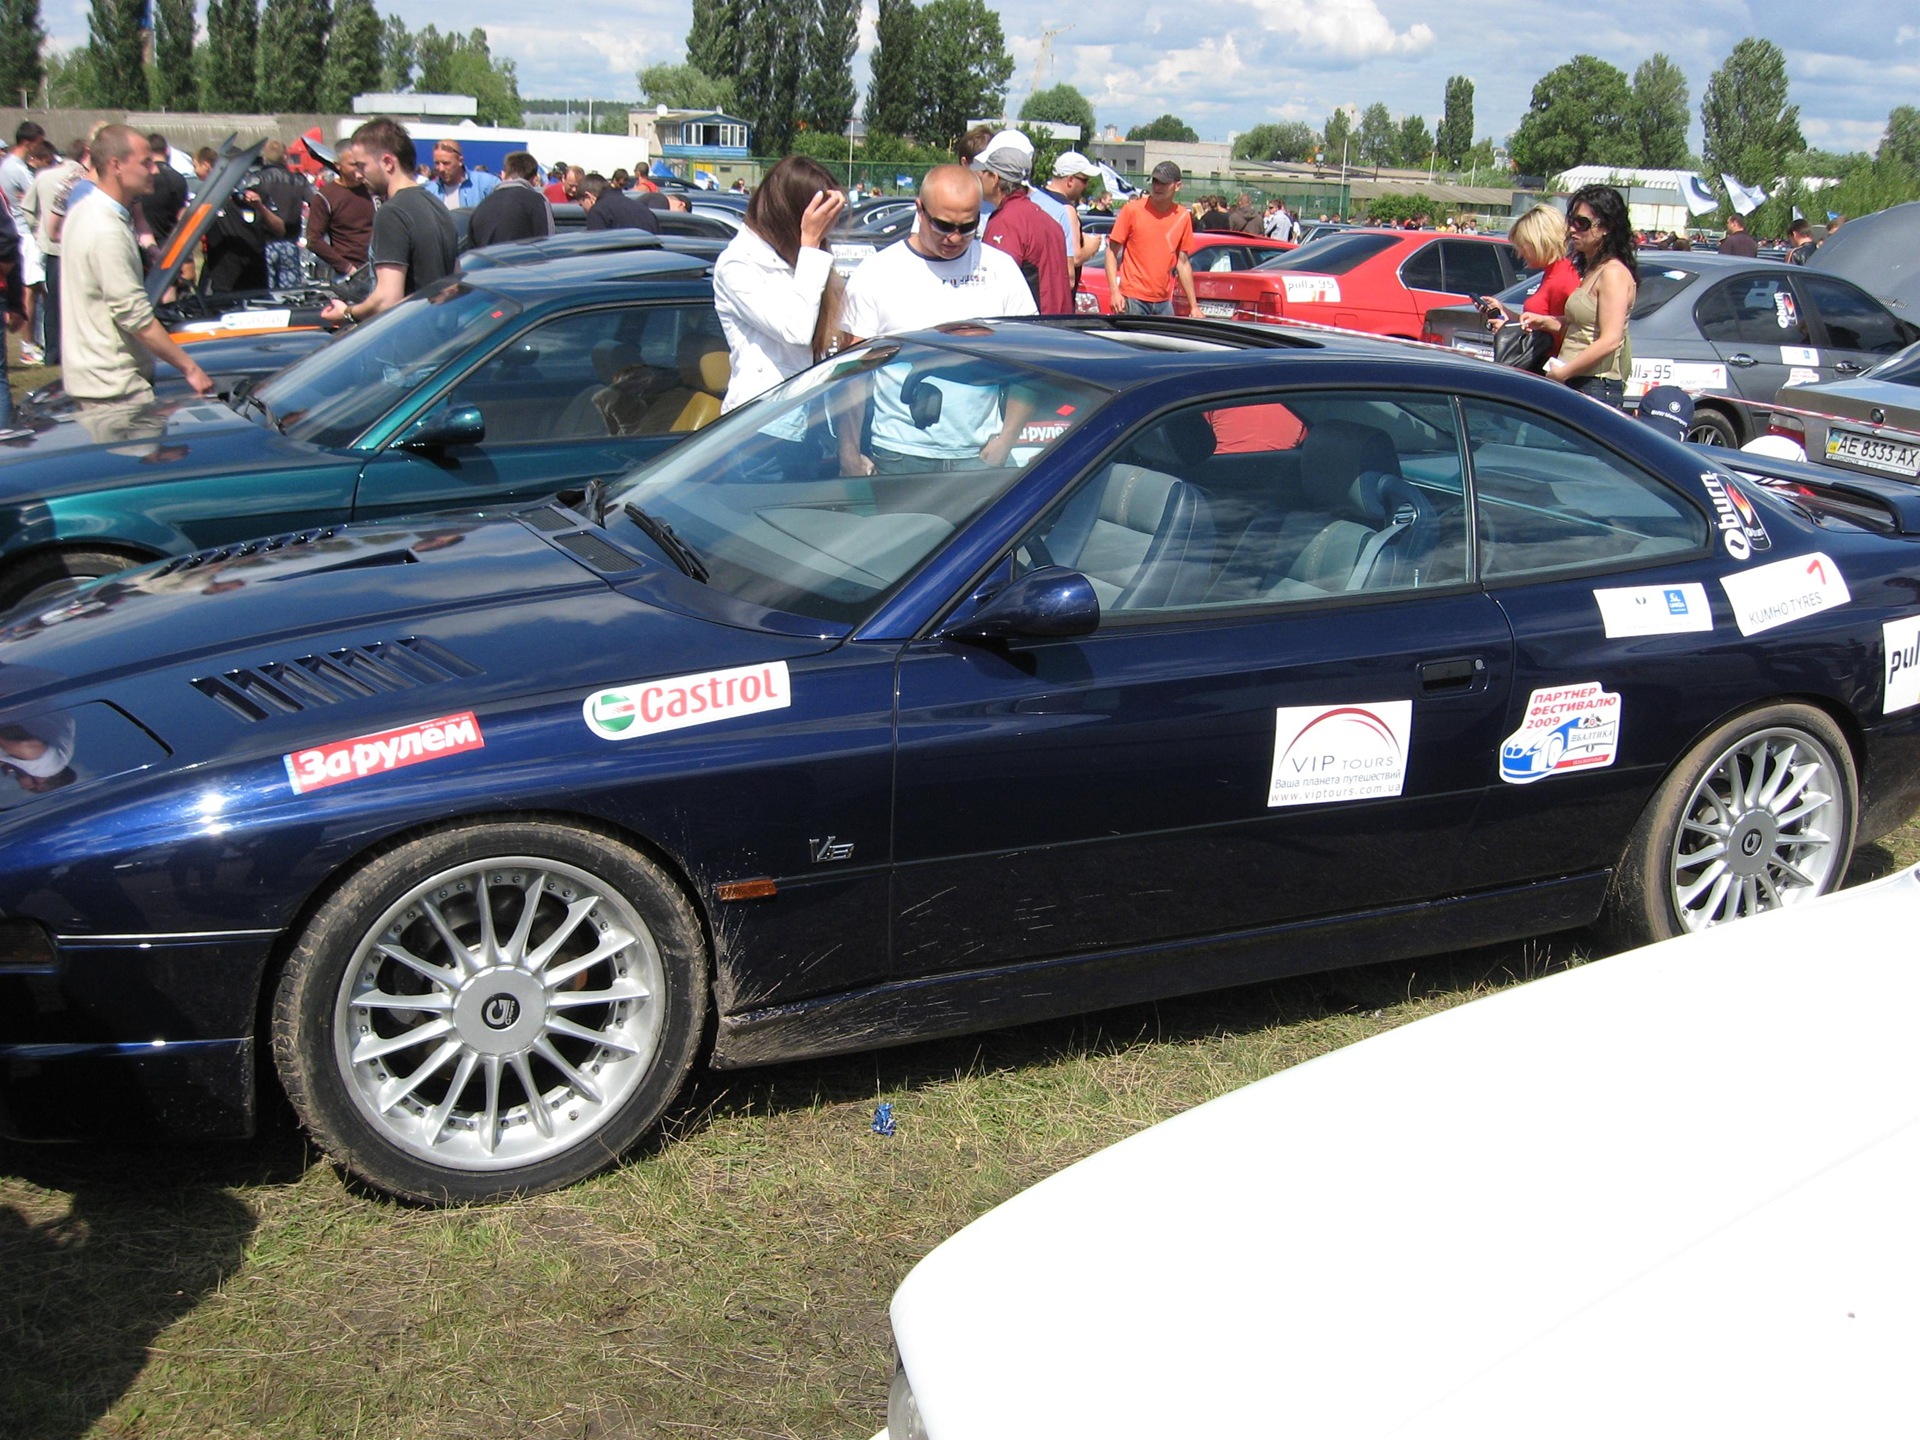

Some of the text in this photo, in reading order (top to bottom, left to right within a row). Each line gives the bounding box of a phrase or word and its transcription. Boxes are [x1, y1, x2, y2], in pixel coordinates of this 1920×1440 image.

[1653, 364, 1672, 380] 95
[1837, 436, 1860, 455] AE
[1861, 440, 1896, 462] 8333
[1896, 448, 1919, 467] AX
[1700, 472, 1741, 530] burn
[1749, 591, 1823, 625] KUMHO TYRES
[640, 668, 778, 724] Castrol
[1533, 687, 1598, 704] ПАРТНЕР
[1530, 697, 1618, 716] ФЕСТИВАЛЮ
[1526, 716, 1561, 729] 2009
[1291, 755, 1394, 773] VIP TOURS
[1275, 768, 1402, 789] Ваша планета путешествий
[1271, 783, 1401, 802] www.viptours.com.ua
